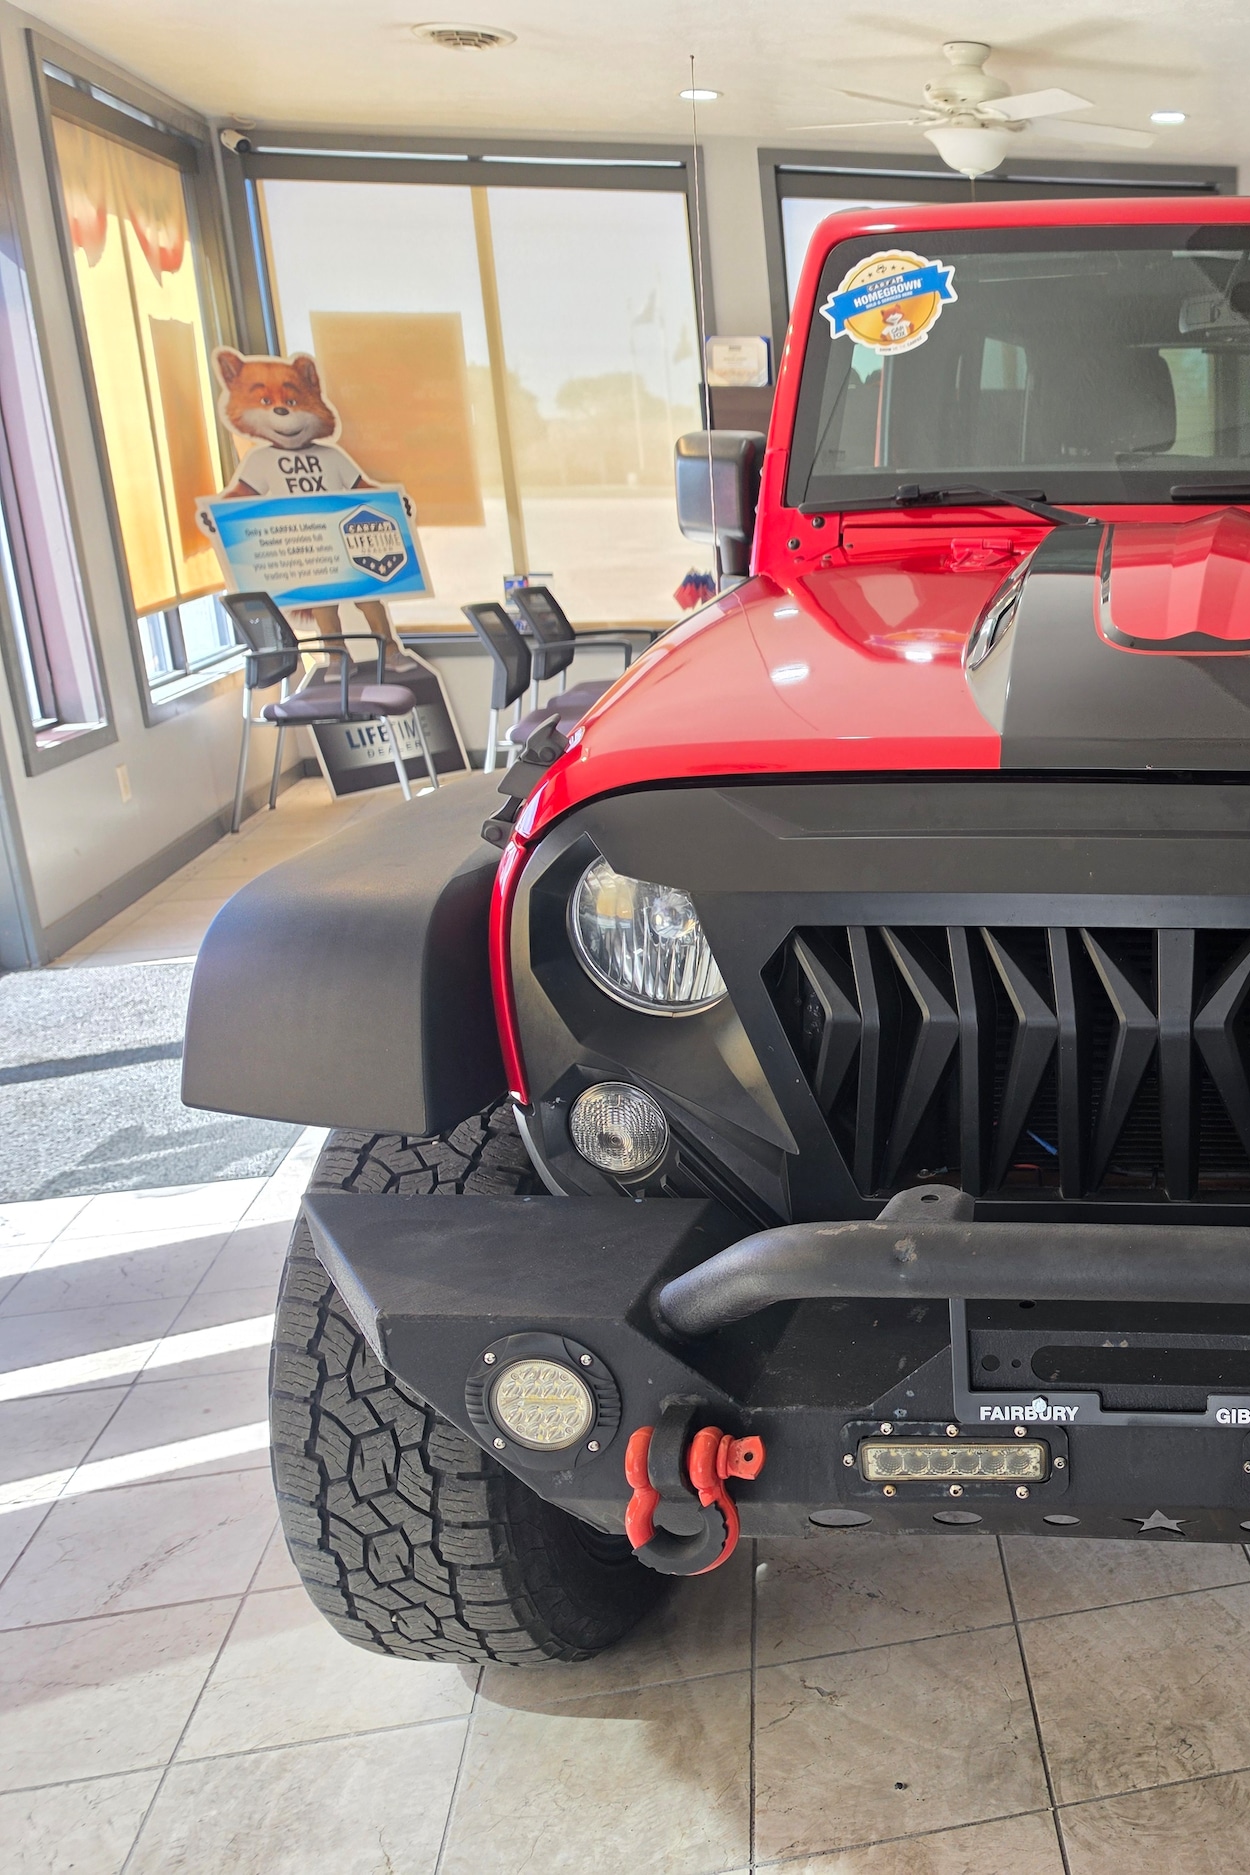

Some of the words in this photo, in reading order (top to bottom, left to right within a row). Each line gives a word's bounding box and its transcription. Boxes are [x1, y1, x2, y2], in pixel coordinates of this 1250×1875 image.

[853, 279, 922, 308] HOMEGROWN
[278, 455, 322, 475] CAR
[285, 476, 327, 494] FOX
[270, 524, 297, 534] CARFAX
[299, 522, 327, 531] Lifetime
[348, 522, 391, 533] CARFAX
[259, 538, 282, 547] Dealer
[347, 532, 400, 549] LIFETIME
[287, 545, 314, 555] CARFAX
[980, 1406, 1079, 1421] FAIRBURY
